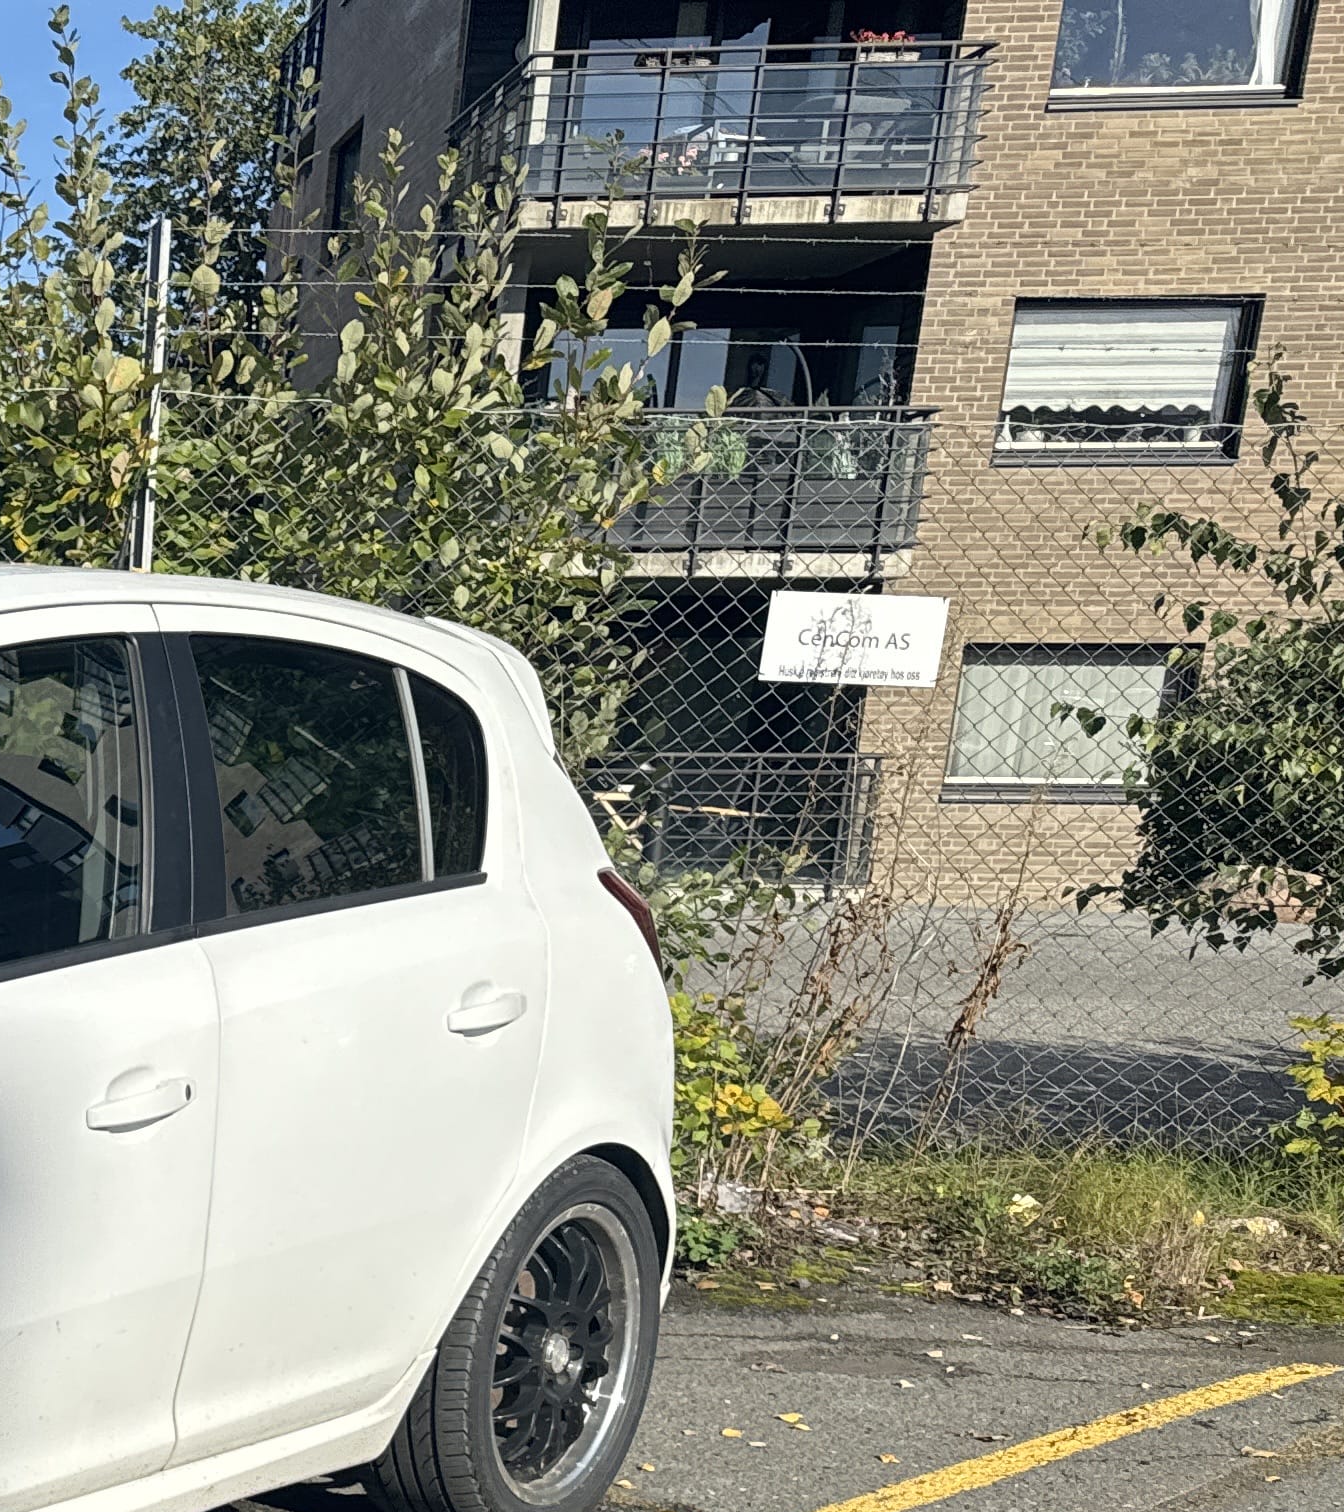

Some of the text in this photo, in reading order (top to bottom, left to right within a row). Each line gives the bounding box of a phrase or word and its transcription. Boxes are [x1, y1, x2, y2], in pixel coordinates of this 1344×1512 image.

[798, 628, 911, 650] CenCom AS
[891, 667, 904, 680] hos
[906, 671, 920, 681] oss
